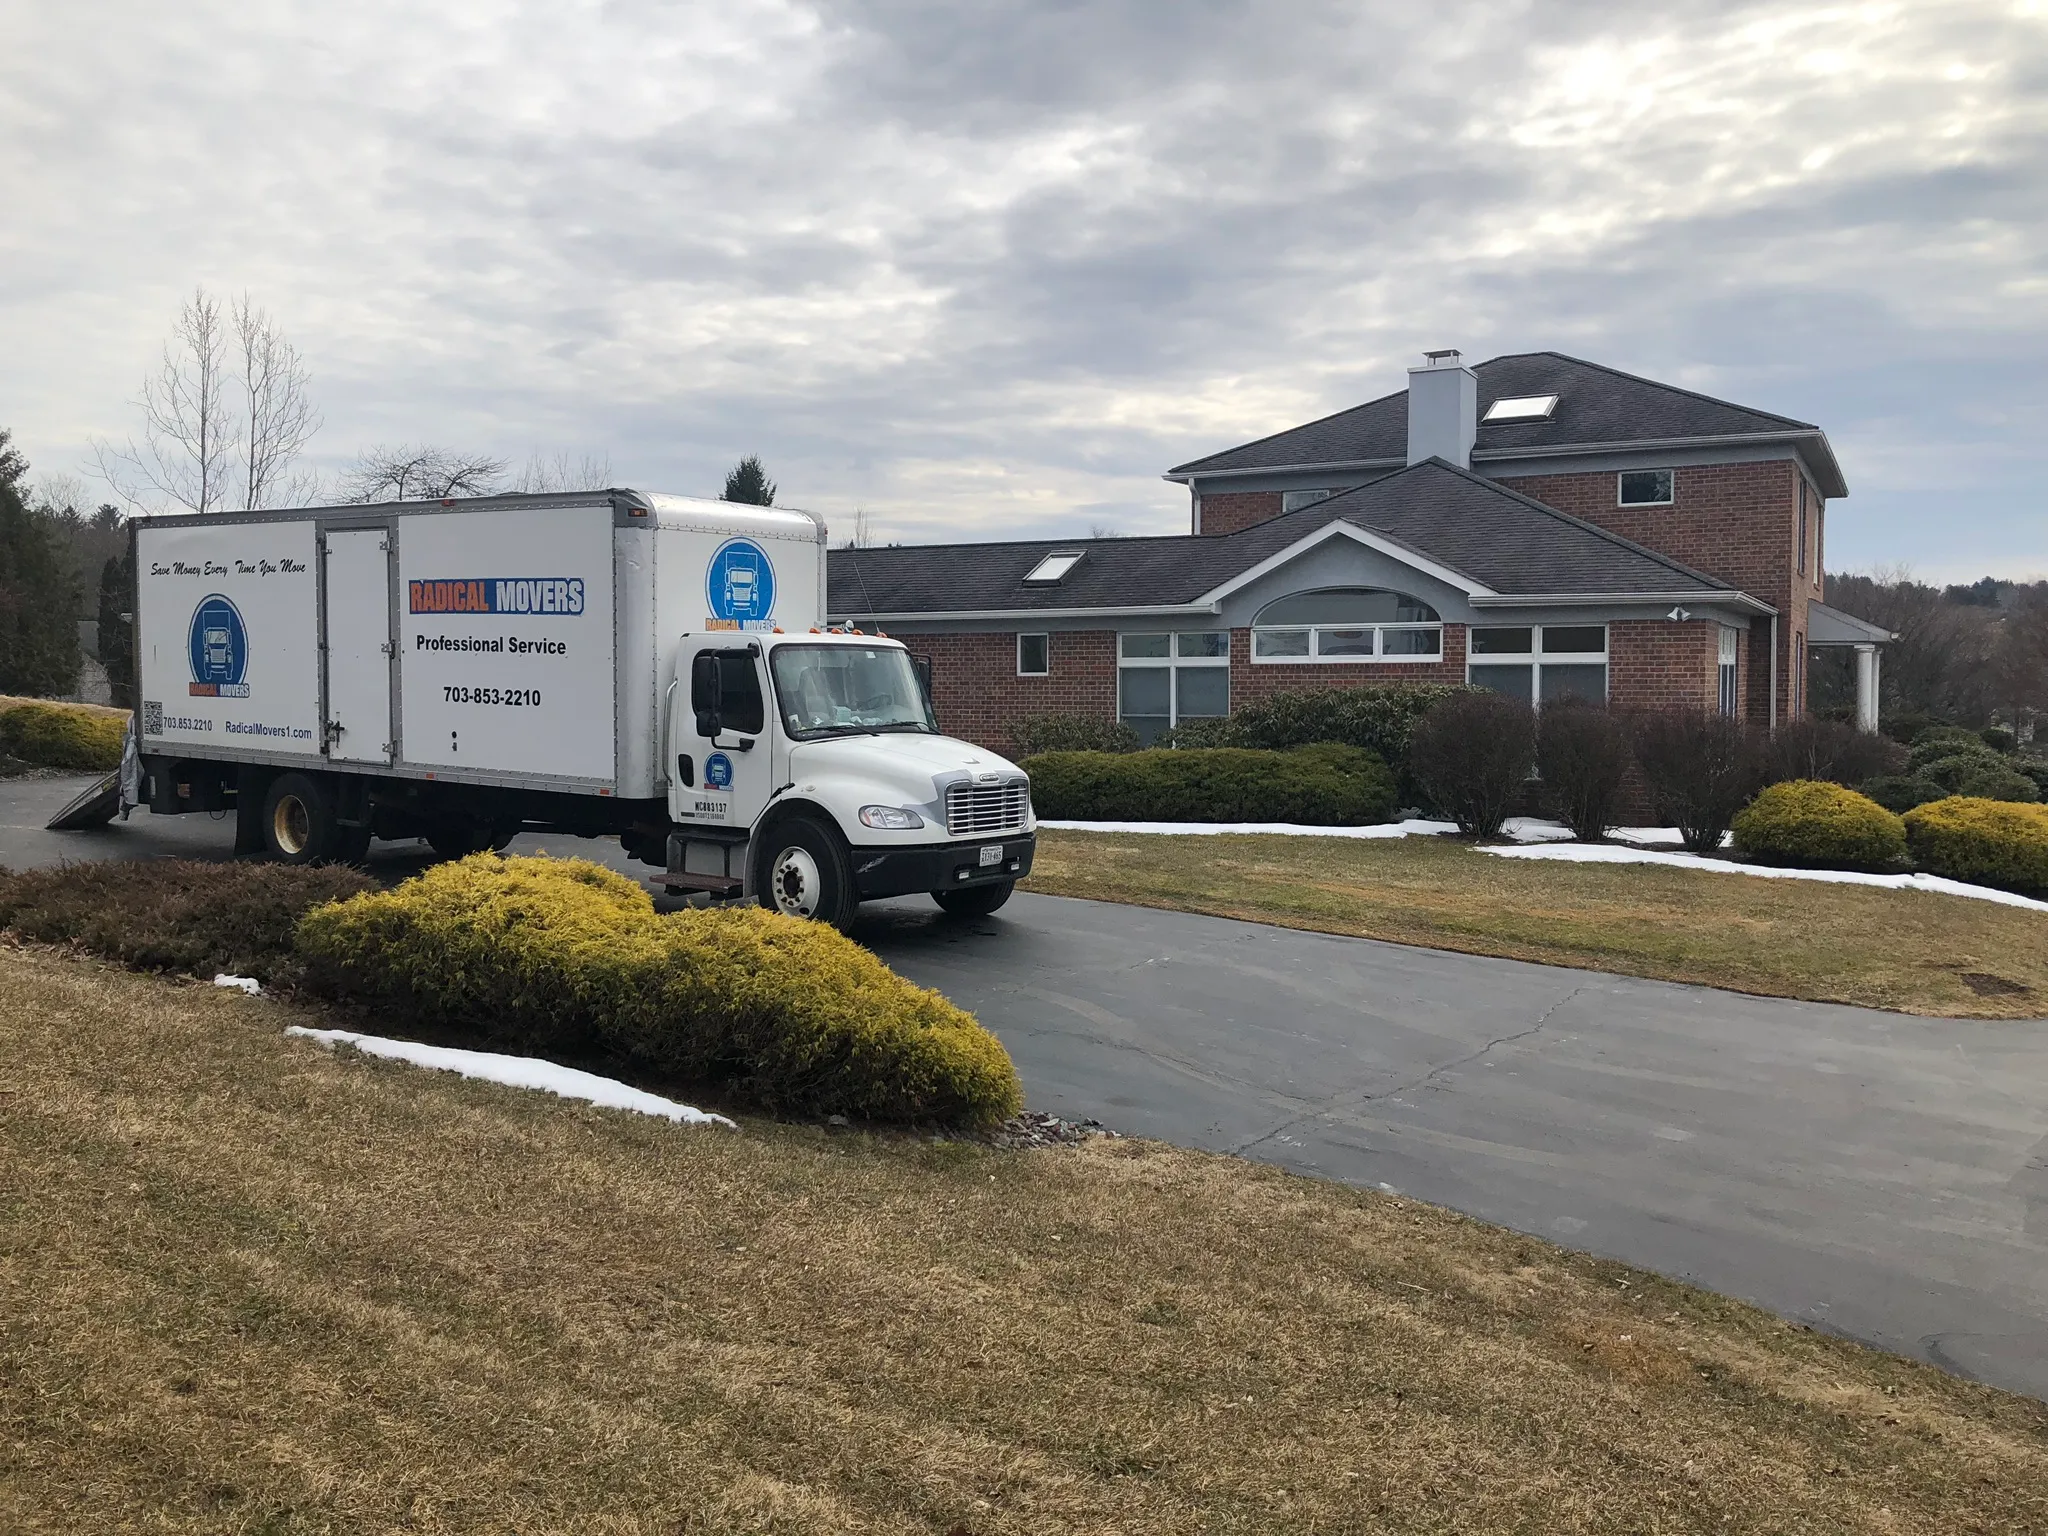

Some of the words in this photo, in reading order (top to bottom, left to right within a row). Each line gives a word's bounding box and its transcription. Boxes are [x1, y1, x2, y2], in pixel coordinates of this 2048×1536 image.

[150, 562, 170, 576] Save
[172, 561, 201, 578] Money
[203, 560, 228, 578] Every
[235, 559, 256, 574] Time
[259, 559, 277, 577] You
[279, 558, 306, 573] Move
[409, 581, 489, 612] RADICAL
[496, 580, 583, 613] MOVERS
[705, 618, 740, 631] RADICAL
[742, 619, 777, 631] MOVERS
[416, 634, 504, 653] Professional
[508, 636, 567, 655] Service
[189, 682, 218, 696] RADICAL
[219, 683, 250, 698] MOVERS
[443, 686, 541, 706] 703-853-2210
[163, 716, 213, 732] 703.853.2210
[225, 720, 312, 739] RadicalMovers1.com
[695, 801, 727, 813] MC883137
